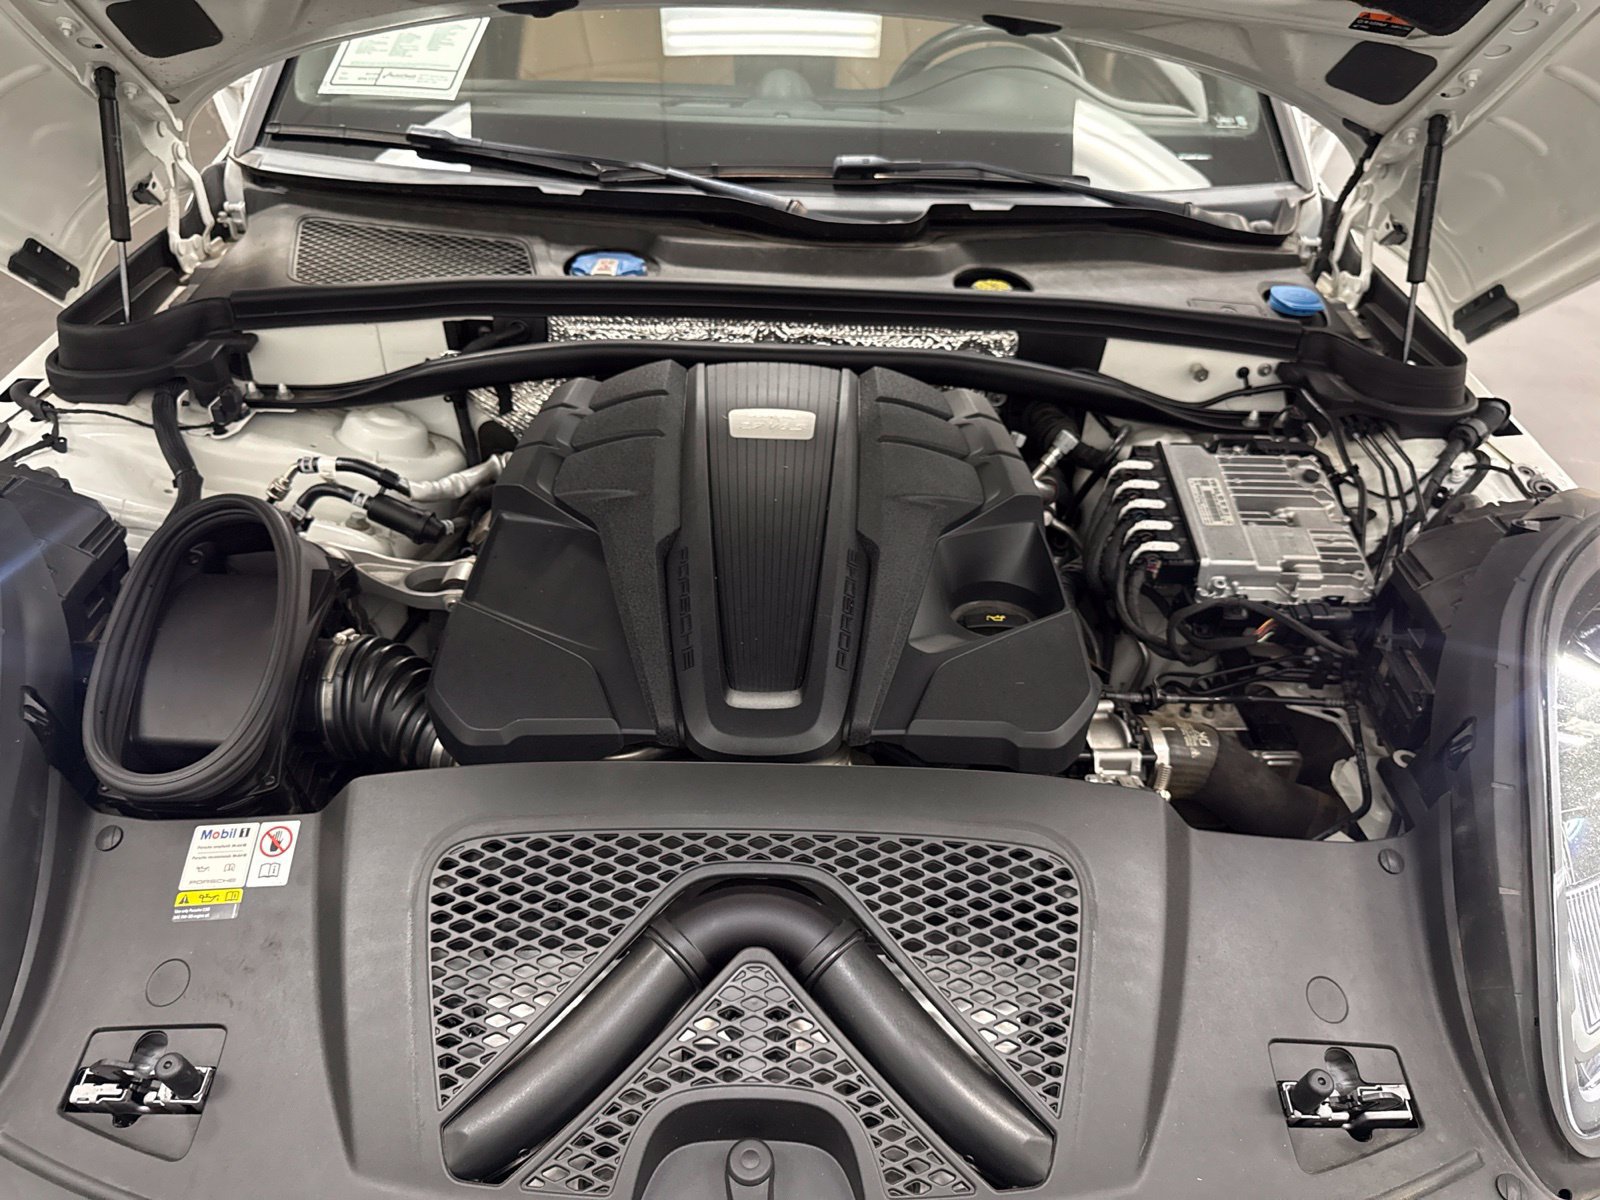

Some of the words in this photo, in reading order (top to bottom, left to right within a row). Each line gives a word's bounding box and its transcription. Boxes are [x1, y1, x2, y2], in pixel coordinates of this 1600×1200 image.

[677, 546, 695, 671] PORSCHE
[835, 548, 860, 671] PORSCHE
[200, 828, 237, 840] Mobil
